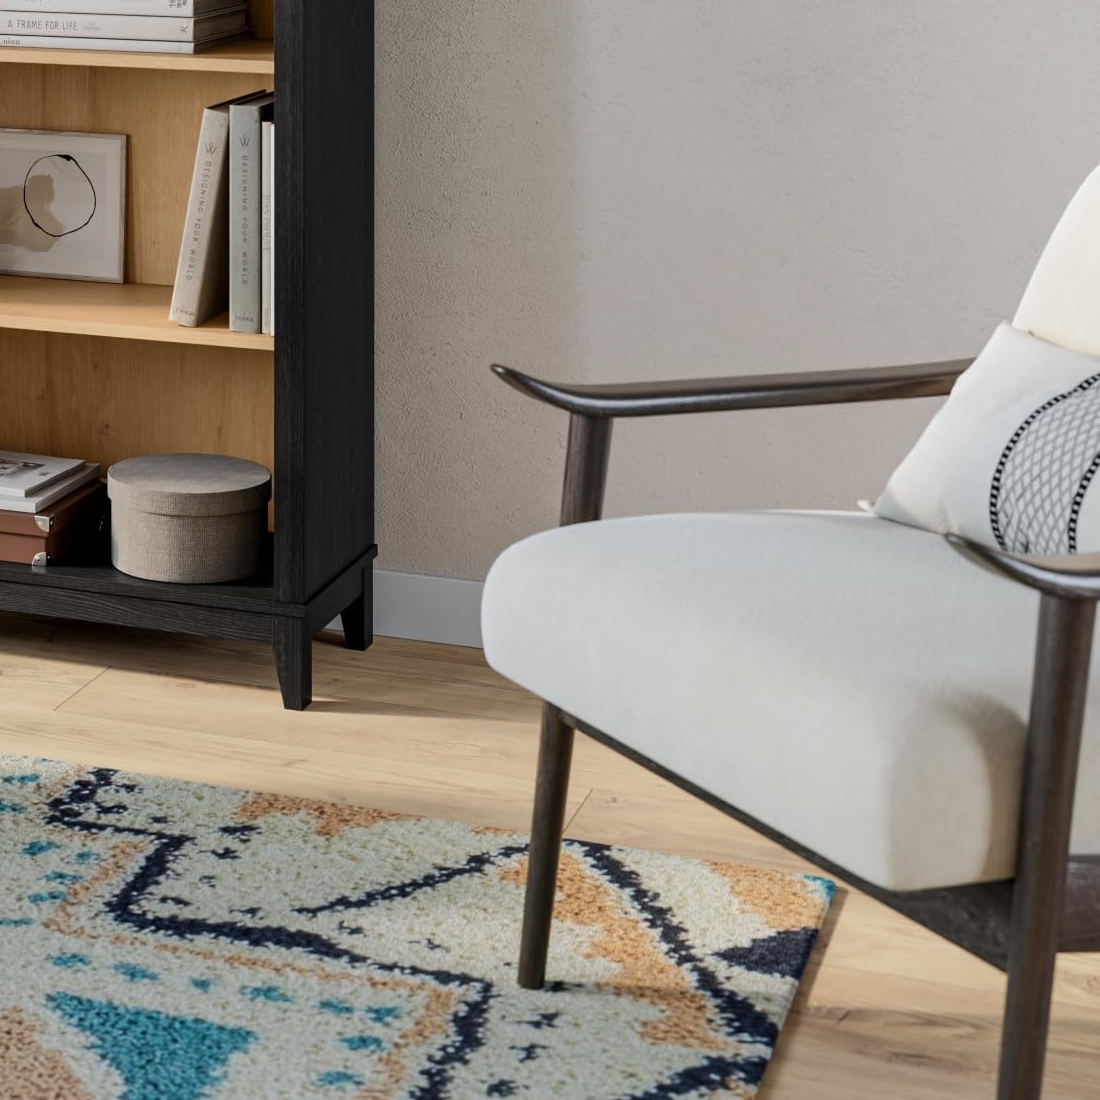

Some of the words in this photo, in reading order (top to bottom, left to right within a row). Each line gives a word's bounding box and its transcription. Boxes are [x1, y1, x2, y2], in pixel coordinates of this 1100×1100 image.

[7, 19, 13, 28] A
[17, 19, 42, 29] FRAME
[45, 20, 59, 30] FOR
[62, 21, 77, 31] LIFE
[198, 161, 212, 212] DESIGNING
[192, 217, 202, 243] YOUR
[186, 249, 197, 281] WORLD
